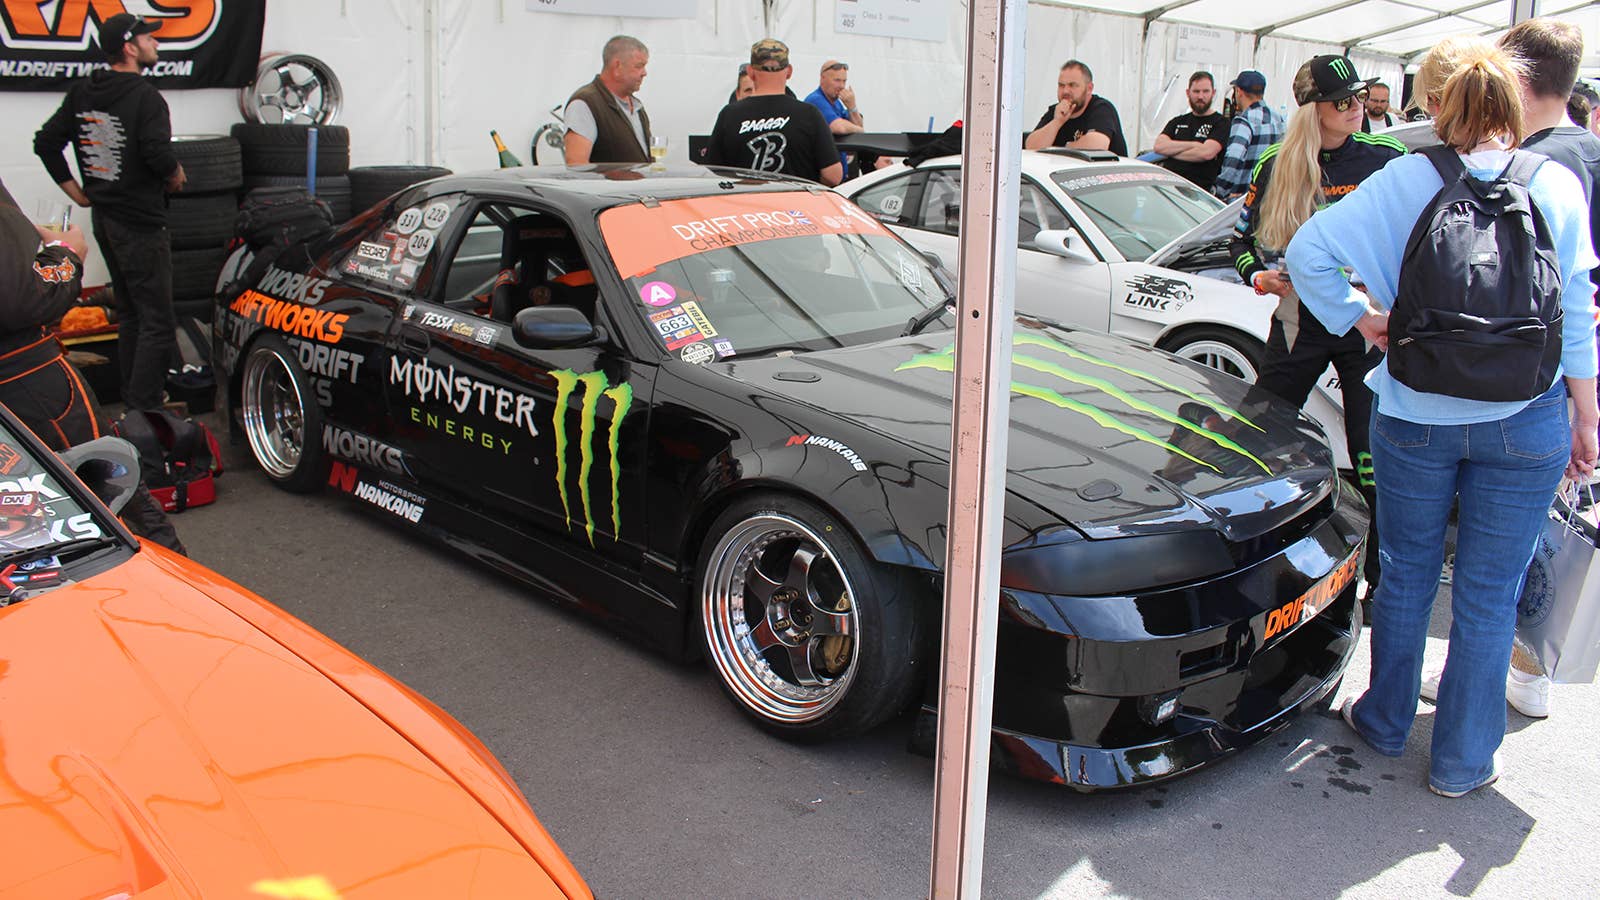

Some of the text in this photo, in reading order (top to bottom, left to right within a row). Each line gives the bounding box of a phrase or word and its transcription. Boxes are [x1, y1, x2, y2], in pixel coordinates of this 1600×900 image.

[842, 18, 855, 28] 405
[739, 116, 790, 134] BAGGSY
[884, 199, 899, 210] 182
[400, 213, 419, 228] 331
[427, 207, 447, 223] 228
[672, 210, 794, 241] DRIFT PRO
[411, 234, 430, 250] 204
[690, 222, 819, 251] CHAMPIONSHIP
[360, 243, 388, 259] RECARO
[257, 262, 333, 306] WORKS
[650, 283, 673, 303] A
[1125, 292, 1171, 311] LINK
[420, 311, 456, 331] TESSA
[660, 316, 689, 333] 663
[389, 354, 539, 437] MONSTER
[410, 407, 513, 455] ENERGY
[804, 434, 868, 472] NANKANG
[354, 480, 425, 524] NANKANG
[378, 479, 427, 505] MOTORSPORT
[1264, 550, 1361, 641] DRIFTWORKS
